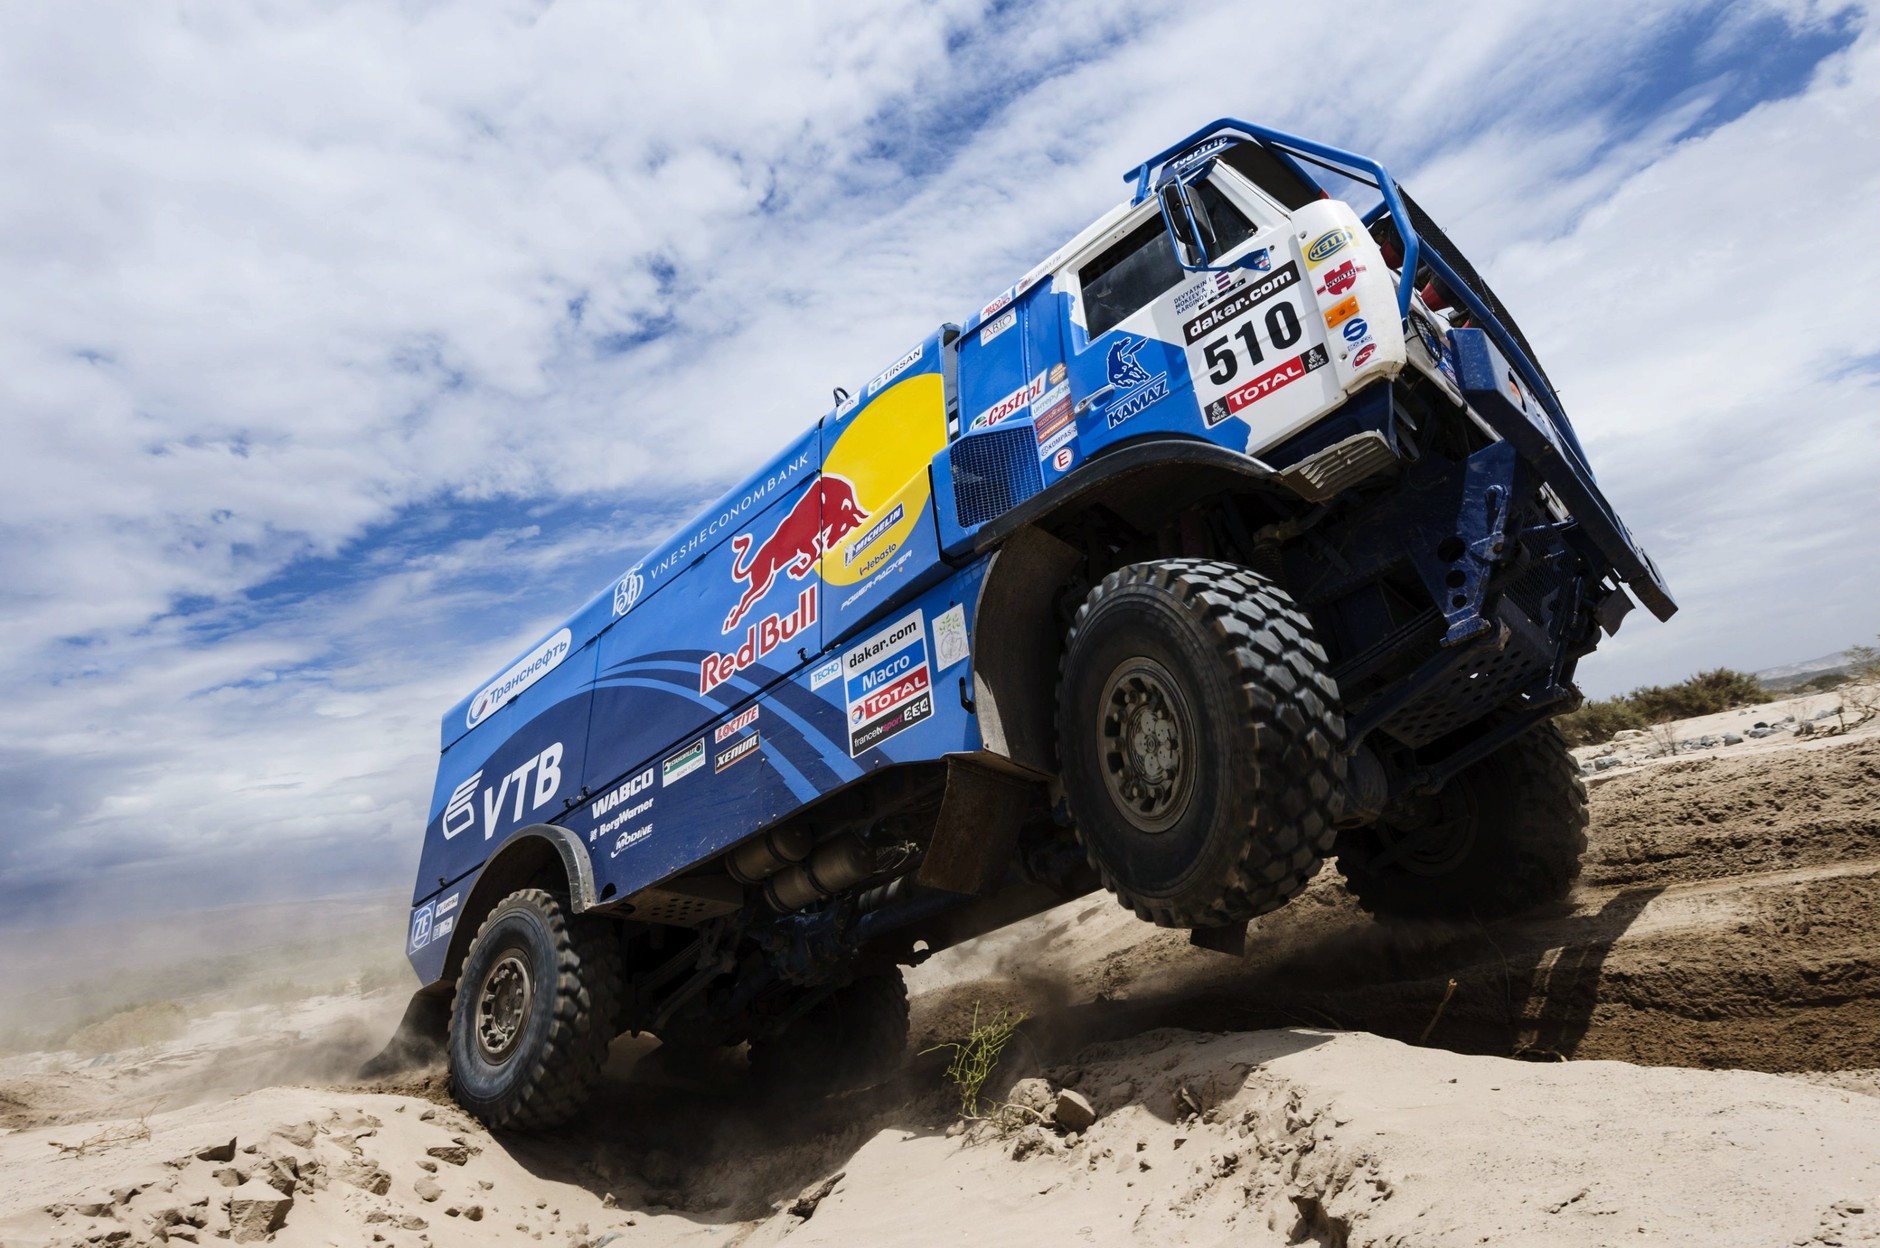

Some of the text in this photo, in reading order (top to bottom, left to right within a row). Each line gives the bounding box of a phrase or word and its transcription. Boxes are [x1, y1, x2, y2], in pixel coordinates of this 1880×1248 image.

[1311, 231, 1354, 258] HELLA
[1174, 279, 1208, 304] DEVYATKIN
[1175, 288, 1201, 310] MOKEEV
[1176, 293, 1208, 316] KARGINOV
[1190, 270, 1292, 338] dakar.com
[1203, 301, 1303, 386] 510
[884, 348, 921, 380] TIRSAN
[988, 374, 1042, 426] Castrol
[1108, 379, 1170, 430] KAMAZ
[1229, 366, 1302, 406] TOTAL
[1057, 451, 1069, 468] E
[651, 451, 809, 579] VNESHECONOMBANK
[855, 507, 902, 553] MICHELIN
[701, 585, 816, 695] Red Bull
[849, 621, 917, 669] dakar.com
[490, 640, 567, 704] Транснефть
[862, 654, 910, 692] Macro
[867, 676, 926, 713] TOTAL
[716, 707, 757, 742] LOCTITE
[484, 742, 564, 841] VTB
[592, 768, 654, 820] WABCO
[600, 797, 654, 837] BorgWarner
[415, 912, 431, 942] ZF
